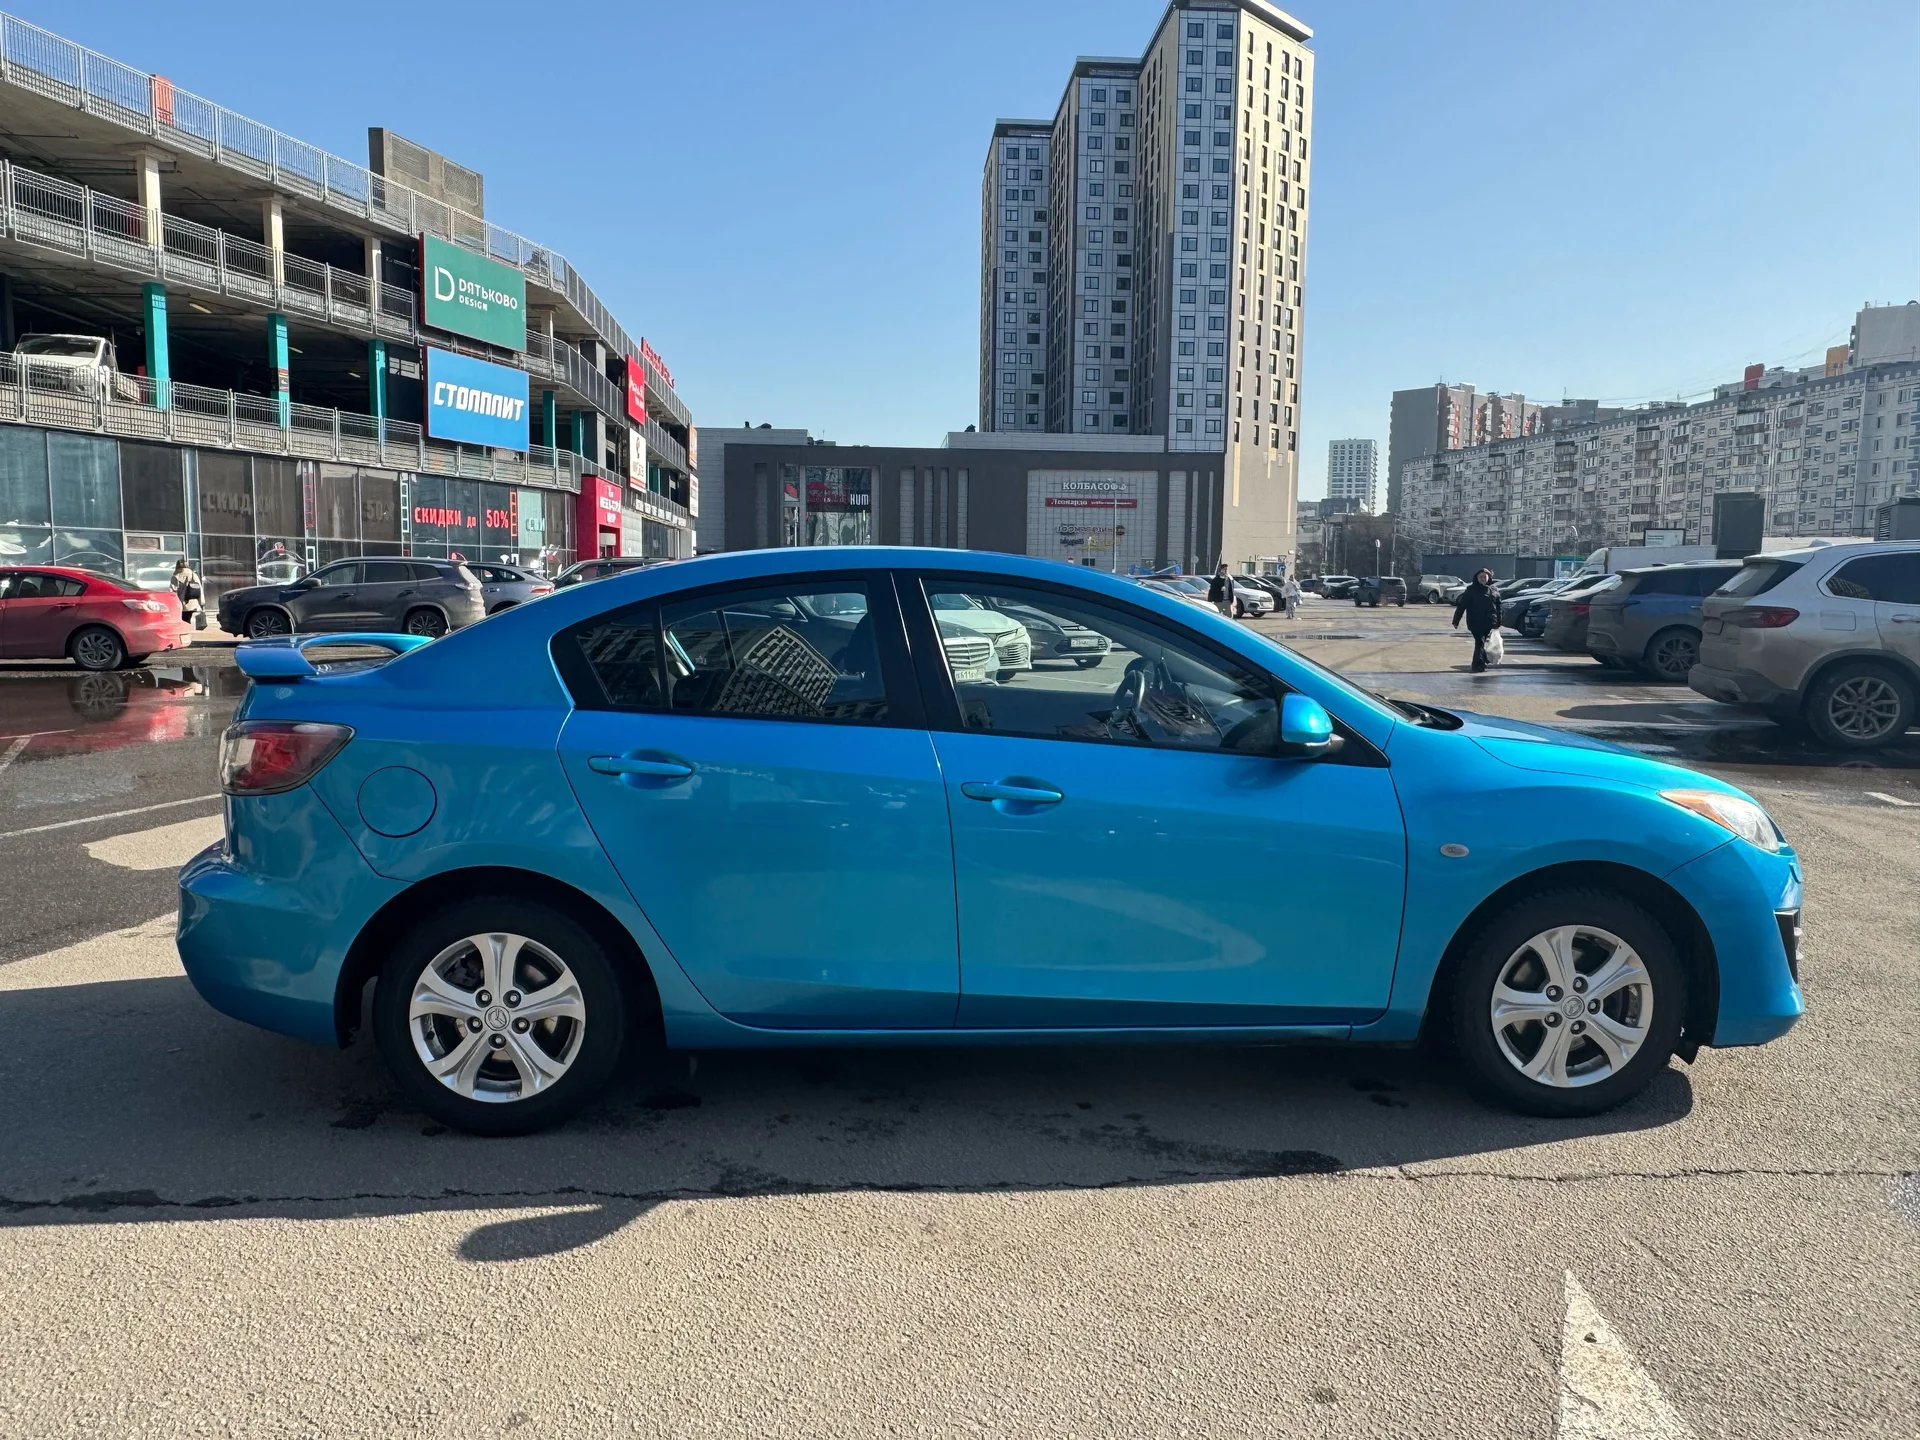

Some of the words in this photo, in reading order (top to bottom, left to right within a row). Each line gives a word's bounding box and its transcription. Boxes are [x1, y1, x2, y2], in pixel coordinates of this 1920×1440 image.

[459, 294, 488, 311] DESIGN
[433, 381, 524, 422] СТОЛПЛИТ
[414, 507, 462, 528] СКИДКИ
[466, 516, 477, 528] до
[486, 509, 509, 529] 50%
